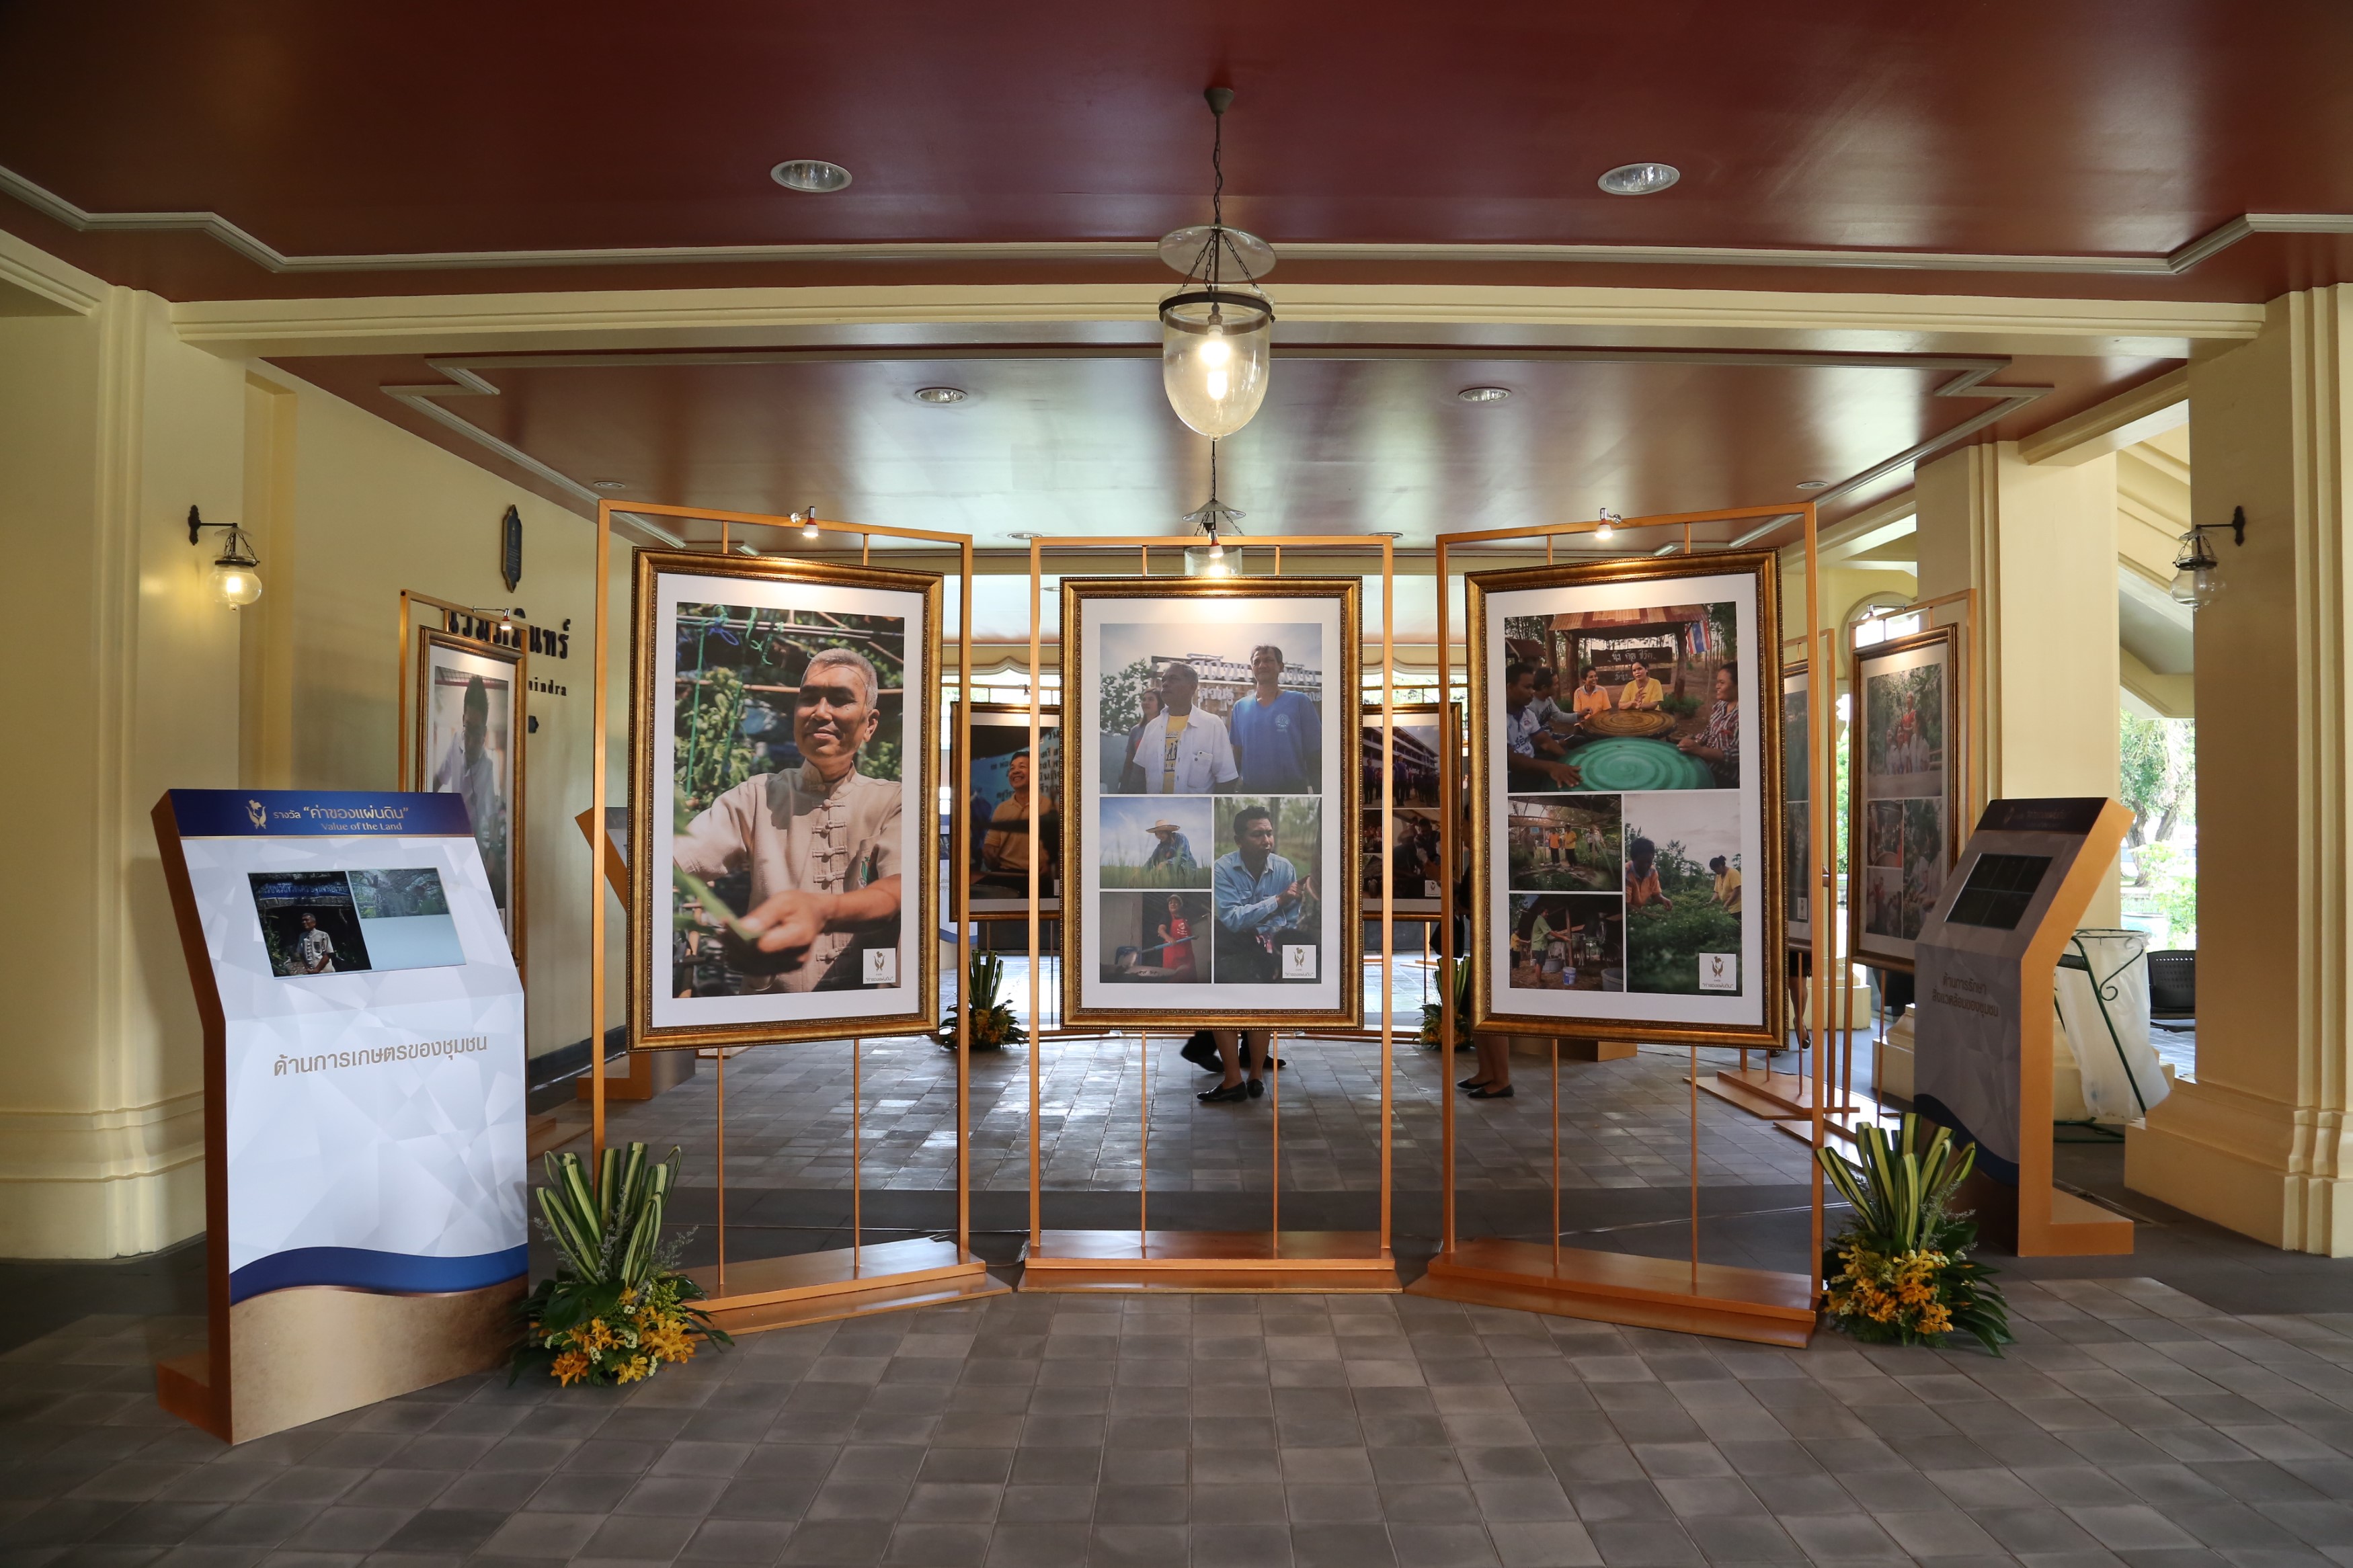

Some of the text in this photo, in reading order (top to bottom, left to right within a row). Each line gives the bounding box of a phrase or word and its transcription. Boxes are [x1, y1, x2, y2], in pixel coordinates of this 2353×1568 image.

[274, 810, 301, 819] รางวัล
[321, 822, 403, 831] Value of the Land
[1942, 971, 1987, 995] ด้านการรักษา
[1931, 985, 1999, 1018] สิ่งแวดล้อมของชุมชน
[274, 1036, 488, 1077] ด้านการเกษตรของชุมชน
